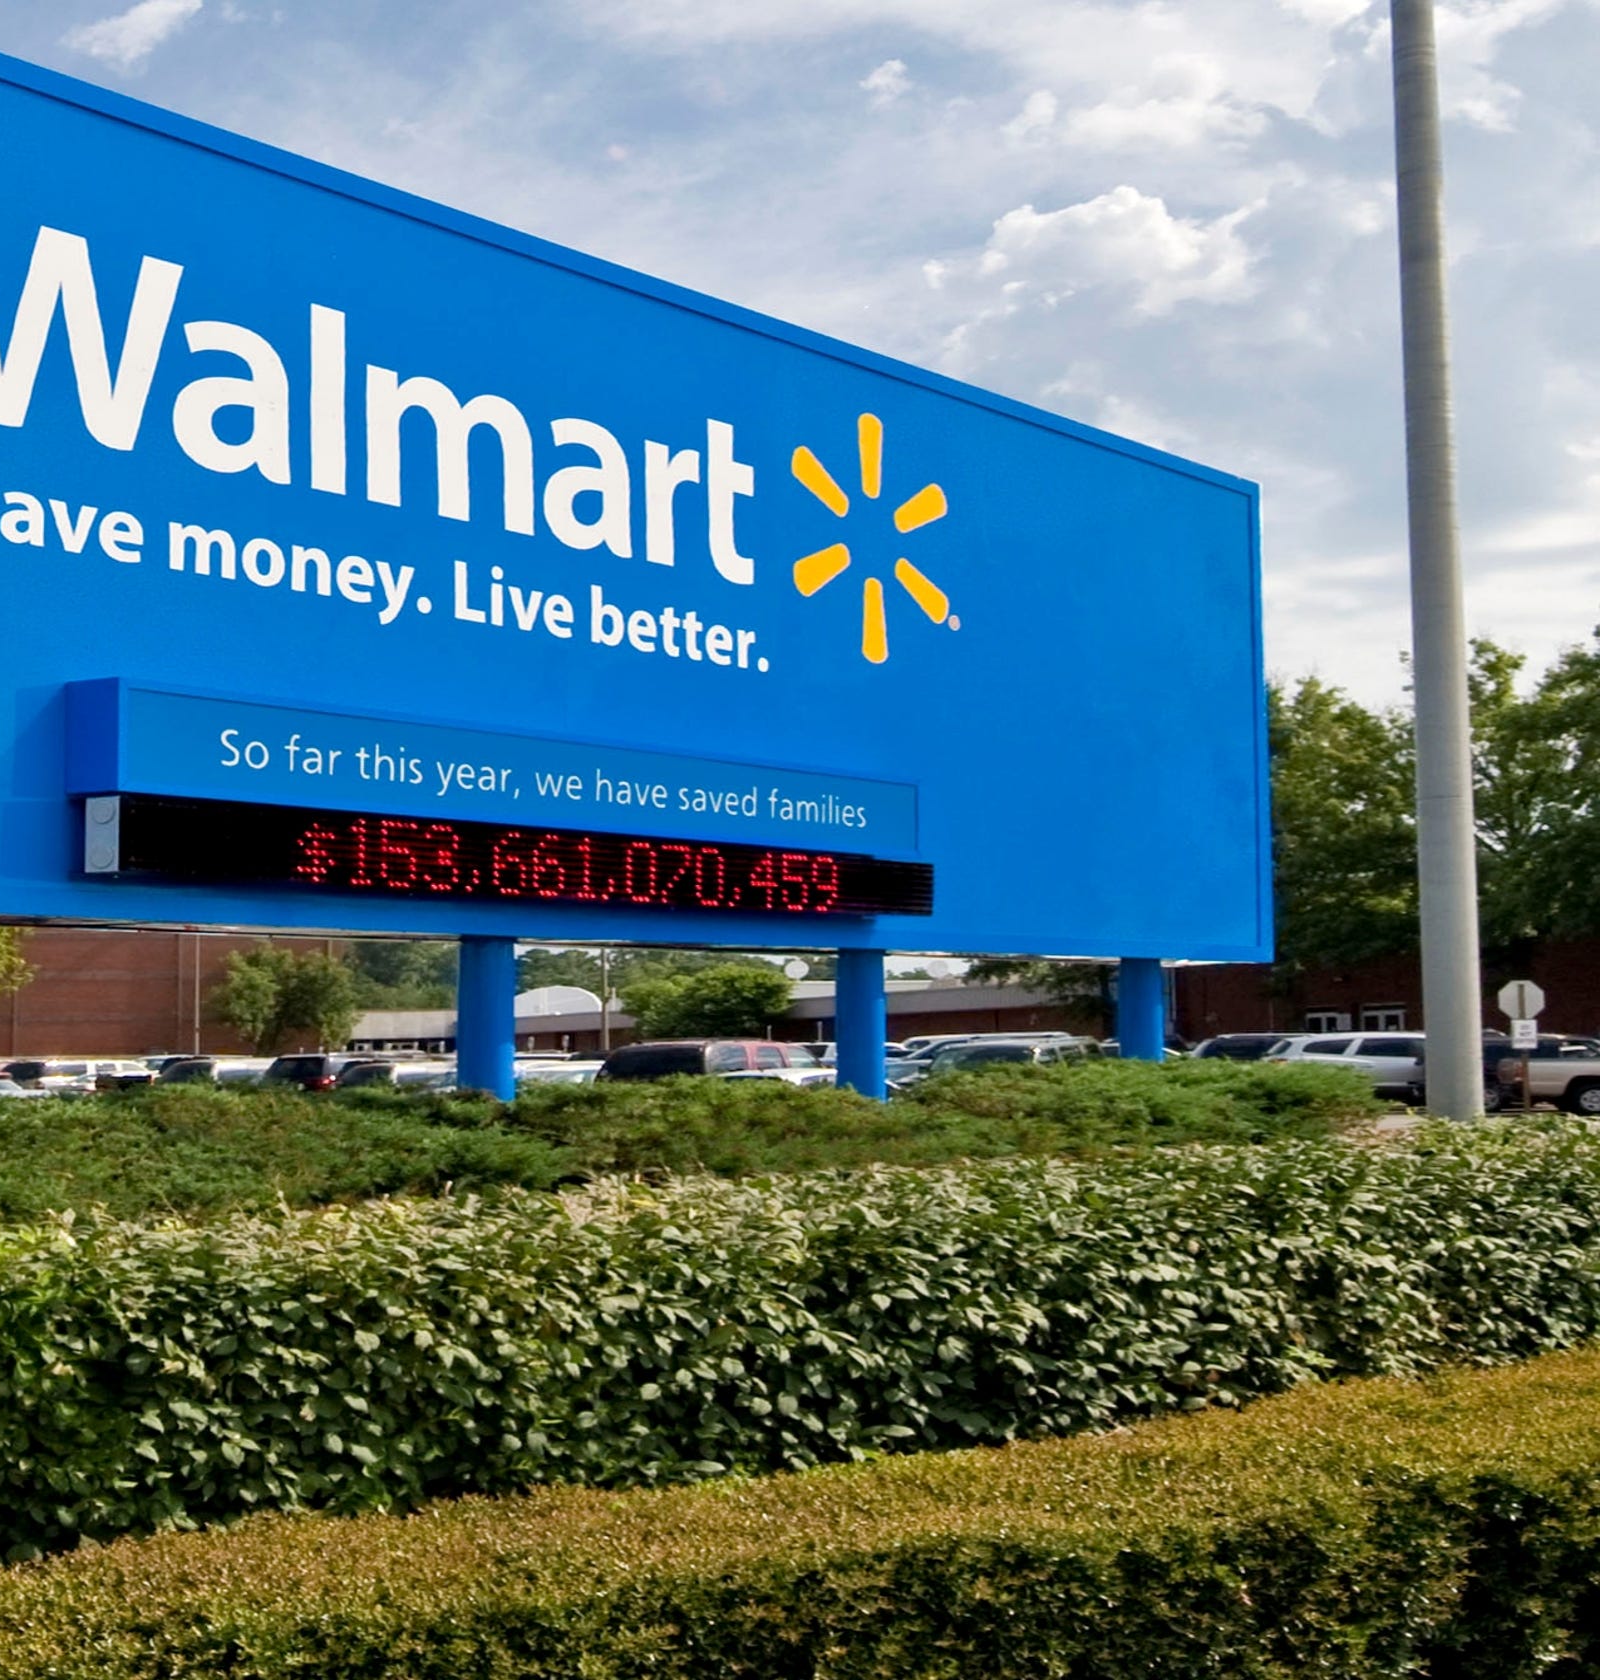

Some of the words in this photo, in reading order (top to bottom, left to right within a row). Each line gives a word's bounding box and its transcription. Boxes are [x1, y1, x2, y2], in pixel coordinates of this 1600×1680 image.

[168, 521, 432, 625] money.
[454, 560, 575, 639] Live
[590, 584, 770, 673] better.
[220, 728, 270, 770] So
[284, 733, 342, 776] far
[355, 743, 424, 785] this
[436, 761, 520, 799] year,
[535, 772, 583, 801] we
[595, 768, 668, 809] have
[678, 779, 758, 818] saved
[768, 787, 868, 828] families
